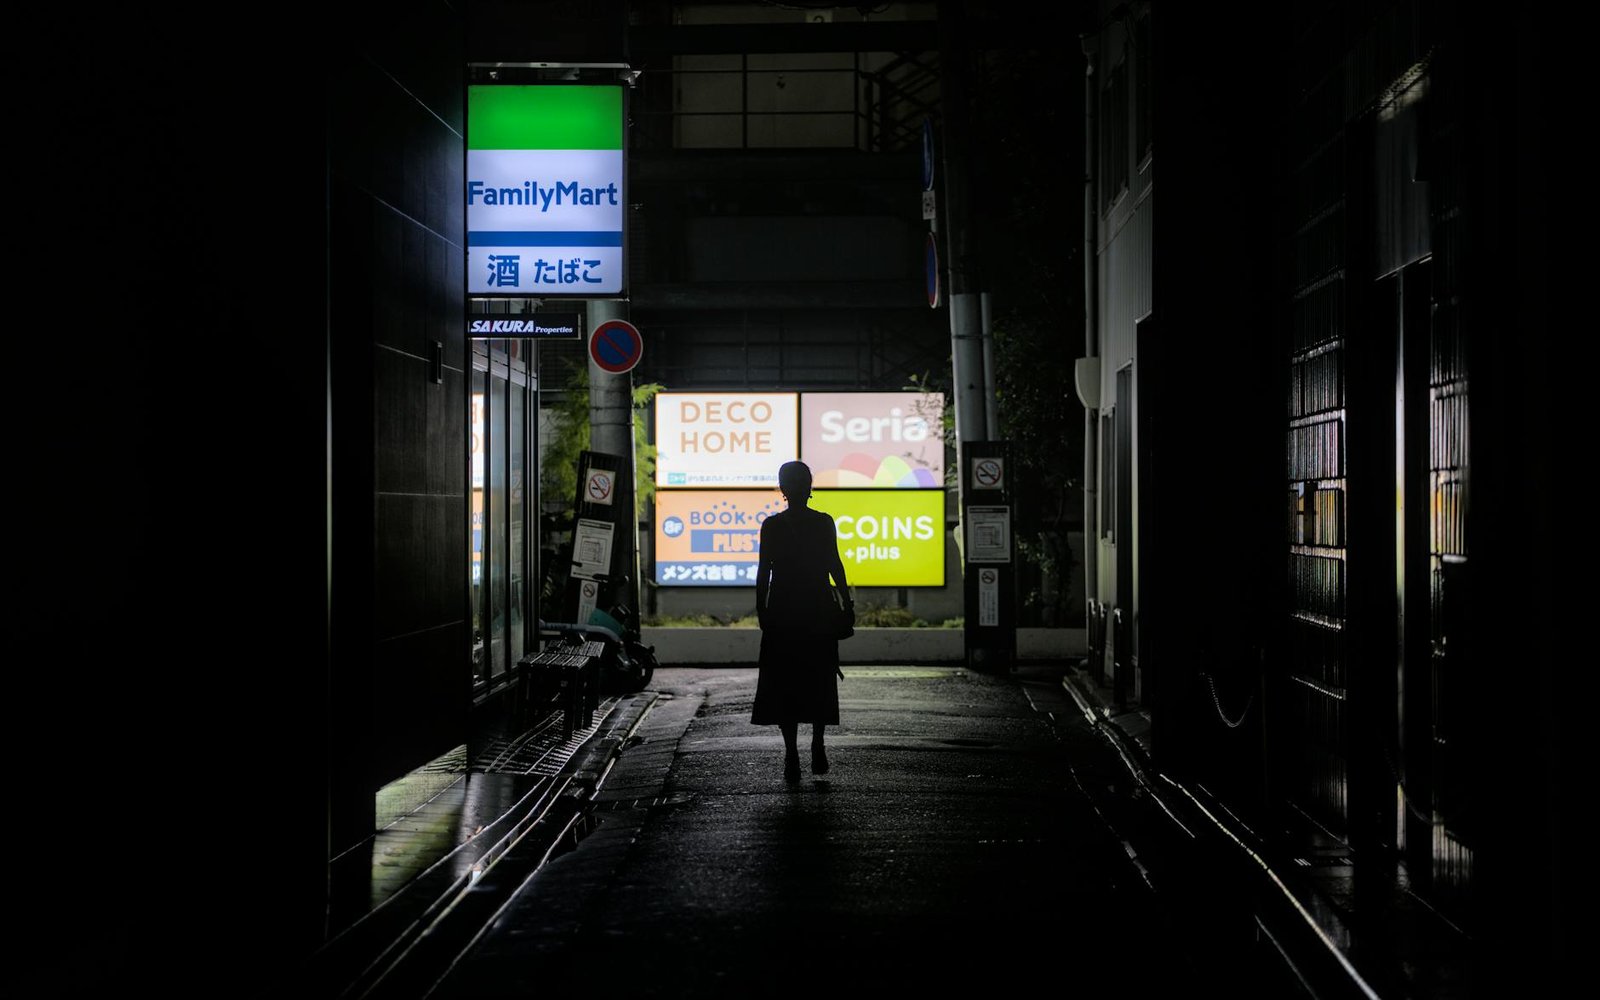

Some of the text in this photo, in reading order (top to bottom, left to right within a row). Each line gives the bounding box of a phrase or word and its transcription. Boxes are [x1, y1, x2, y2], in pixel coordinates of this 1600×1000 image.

[468, 181, 618, 212] FamilyMart
[487, 254, 602, 287] 酒 たばこ
[470, 320, 573, 335] SAKURA Properties
[680, 401, 773, 424] DECO
[821, 407, 928, 443] Seria
[680, 431, 772, 454] HOME
[835, 515, 934, 541] COINS
[844, 542, 900, 564] +plus
